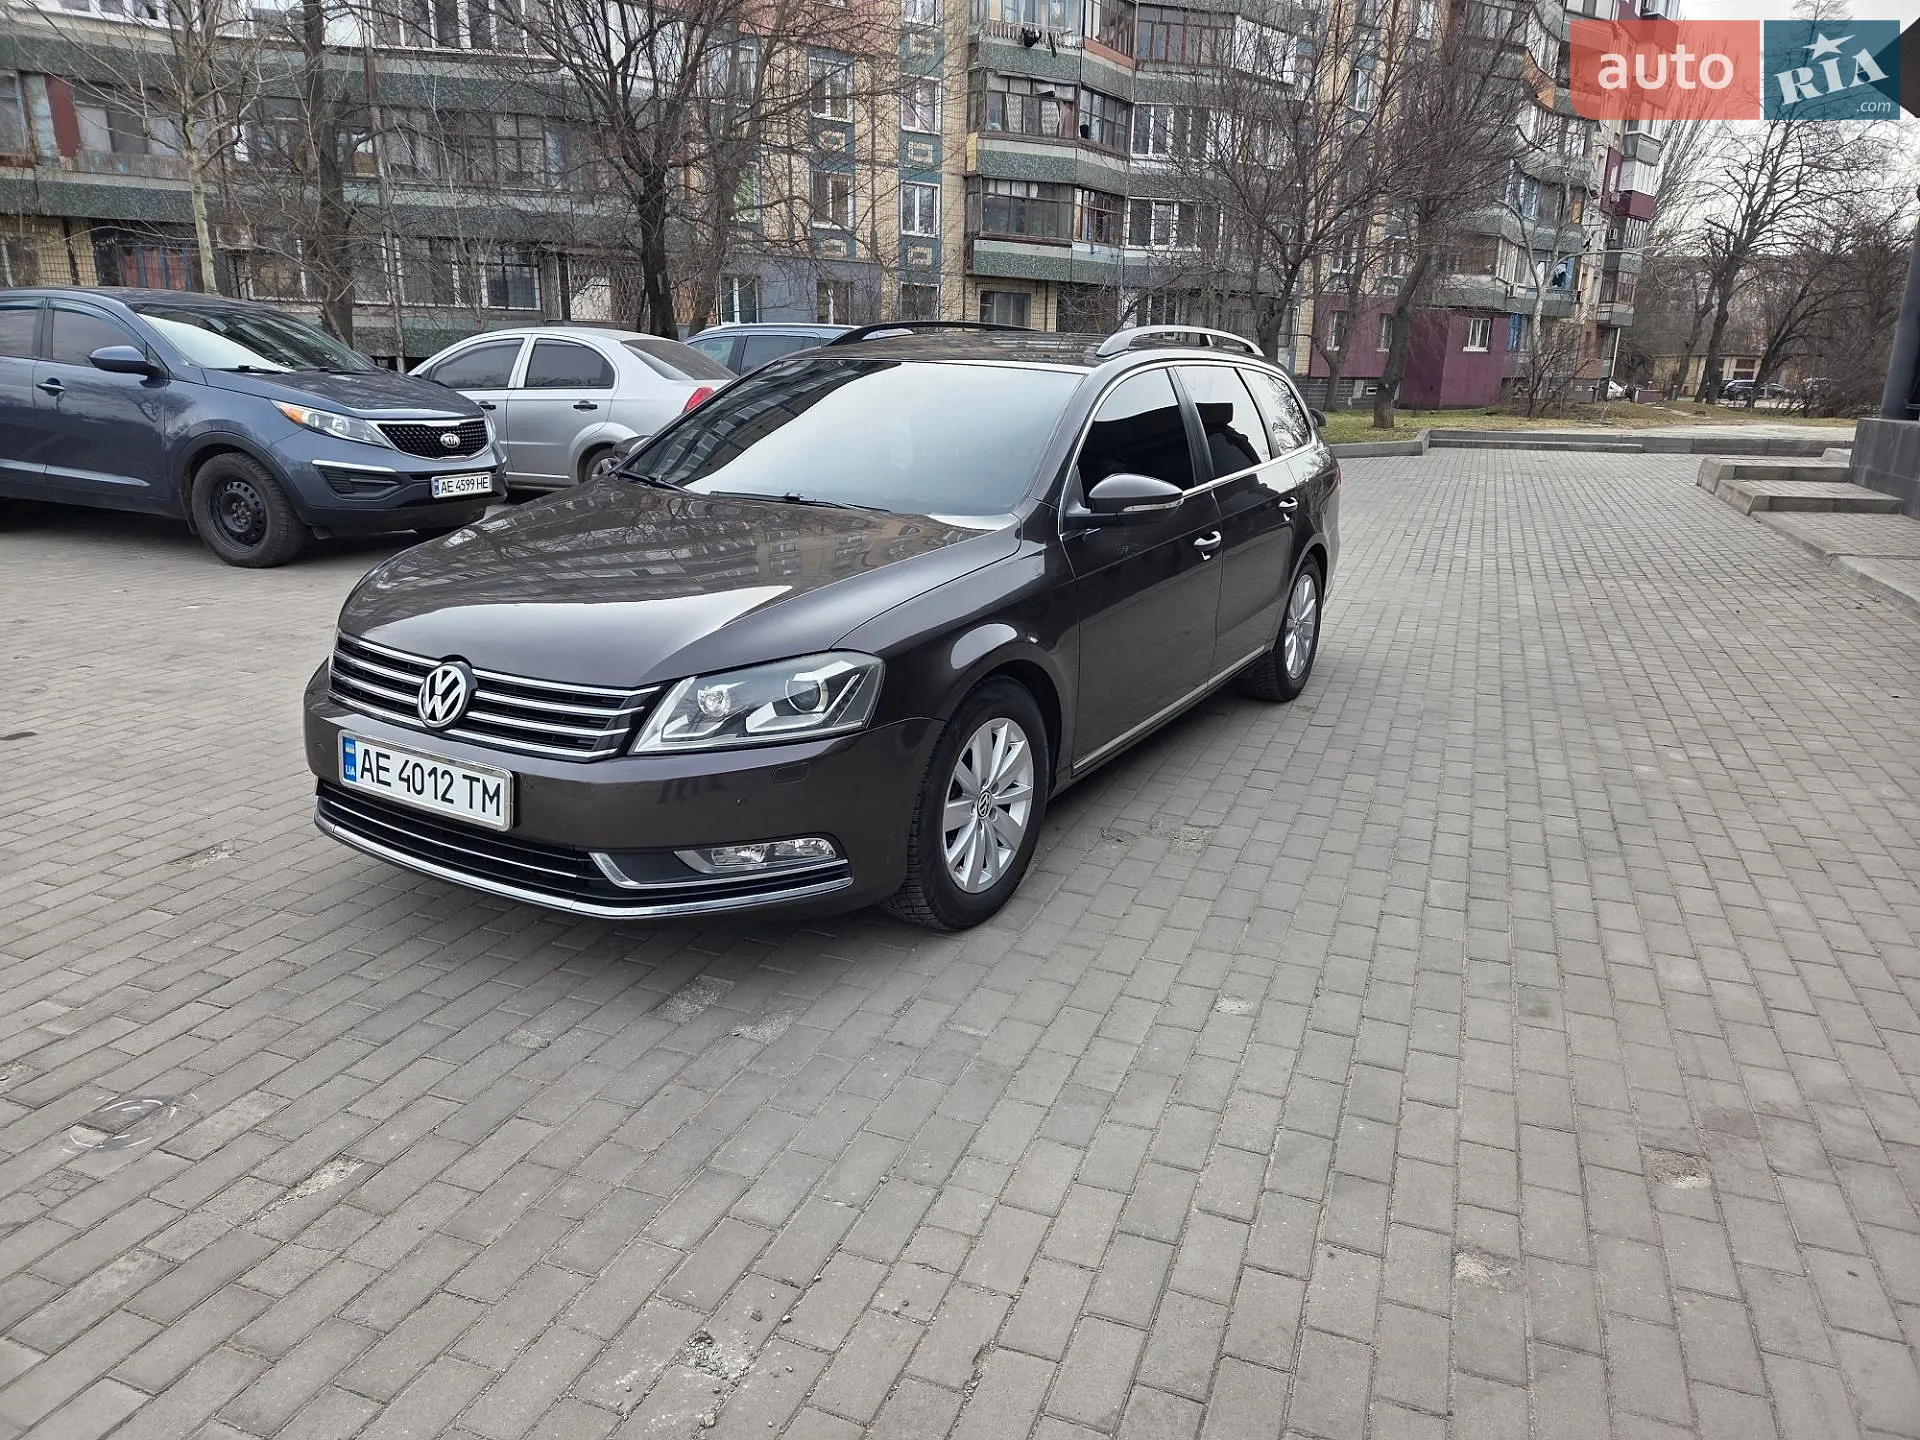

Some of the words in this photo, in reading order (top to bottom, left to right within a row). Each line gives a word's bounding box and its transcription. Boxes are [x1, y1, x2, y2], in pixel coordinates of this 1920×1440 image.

[441, 481, 453, 494] AE
[456, 479, 474, 491] 4599
[476, 477, 488, 490] HE
[345, 765, 356, 775] UA
[360, 748, 392, 787] AE
[398, 759, 454, 805] 4012
[462, 773, 501, 817] TM
